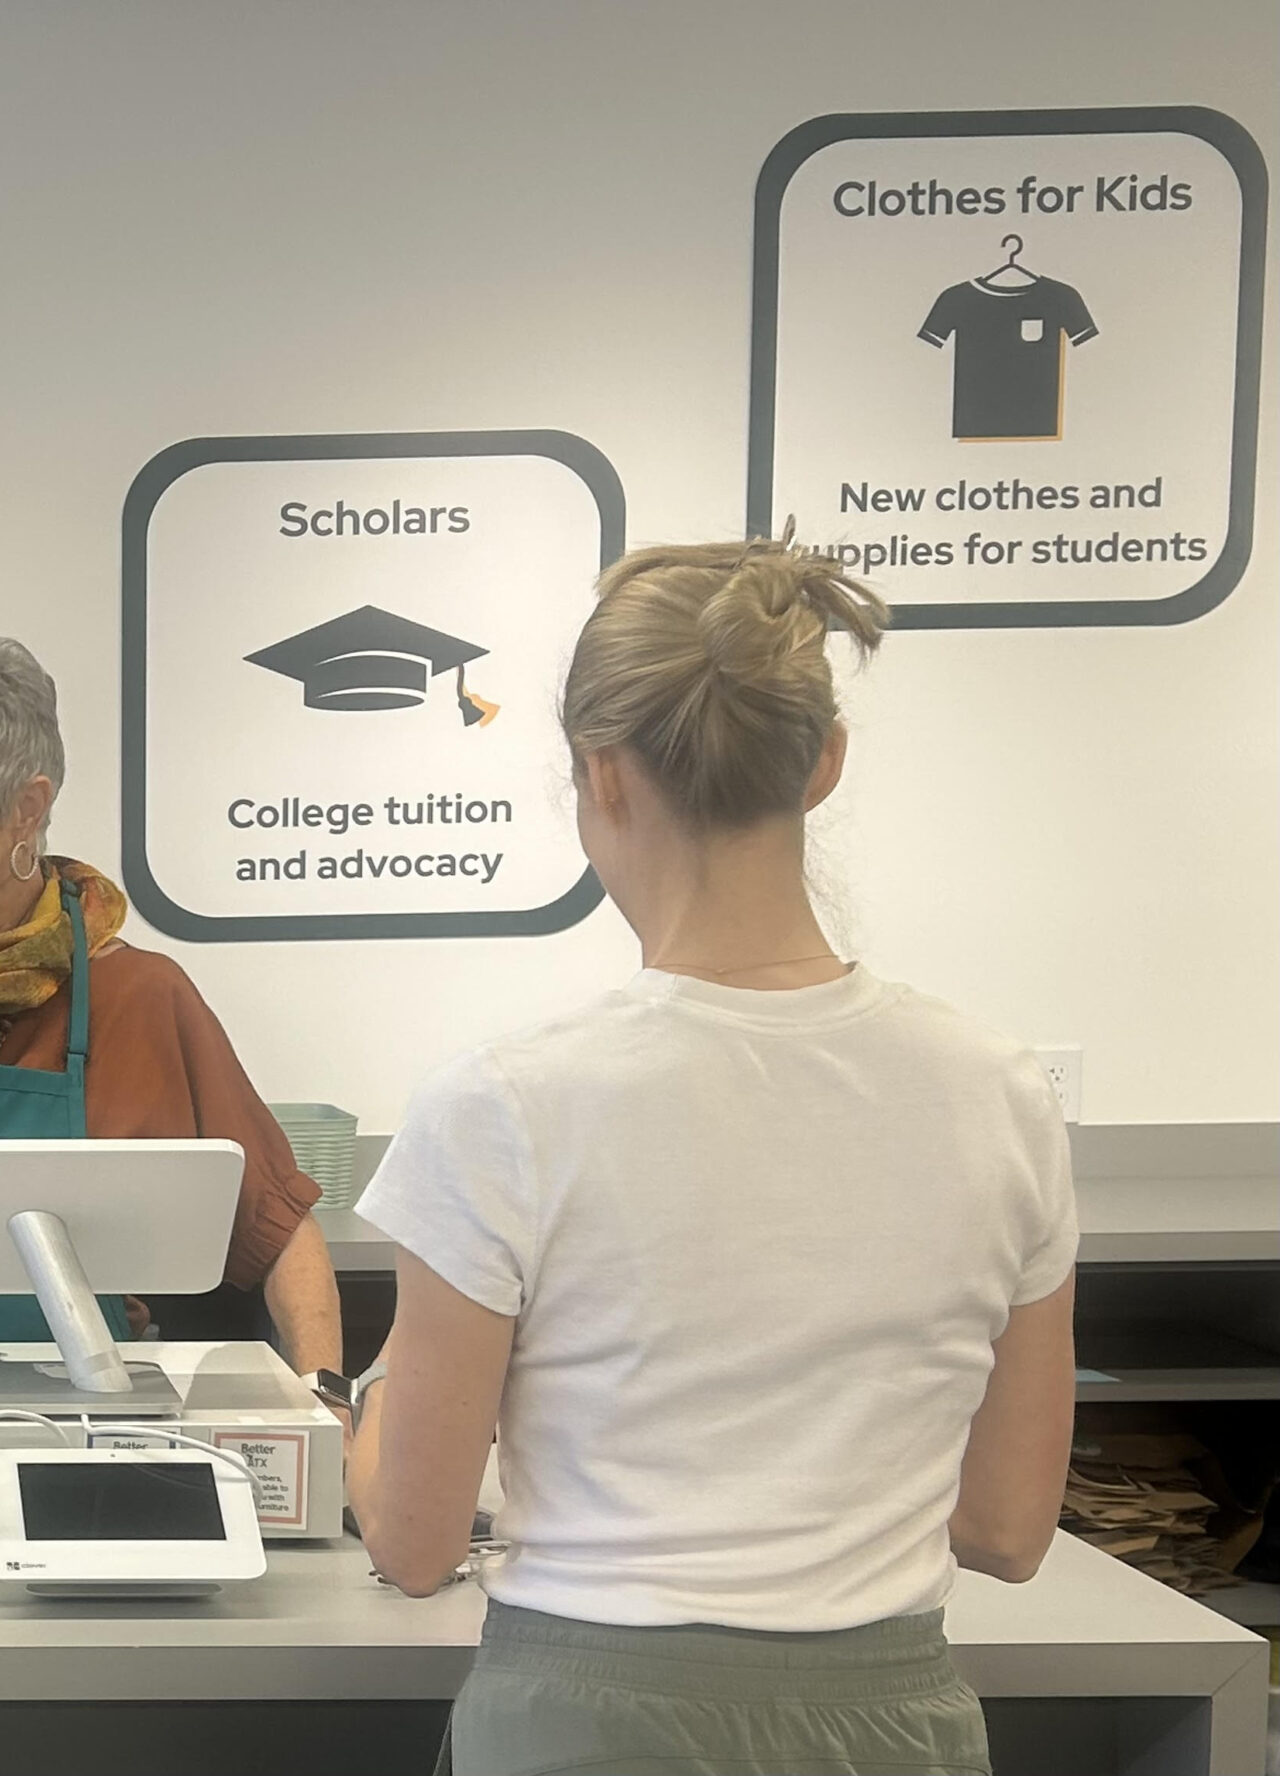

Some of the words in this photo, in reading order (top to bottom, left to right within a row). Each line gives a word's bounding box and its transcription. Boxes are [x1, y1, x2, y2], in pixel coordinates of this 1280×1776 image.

[833, 179, 1006, 217] Clothes
[1017, 176, 1084, 213] for
[1096, 174, 1192, 212] Kids
[840, 482, 926, 512] New
[935, 478, 1080, 511] clothes
[1090, 477, 1162, 509] and
[279, 500, 470, 536] Scholars
[964, 532, 1022, 565] for
[1032, 532, 1208, 564] students
[227, 797, 374, 834] College
[383, 793, 513, 826] tuition
[235, 849, 307, 881] and
[316, 848, 504, 884] advocacy
[241, 1443, 276, 1455] Better
